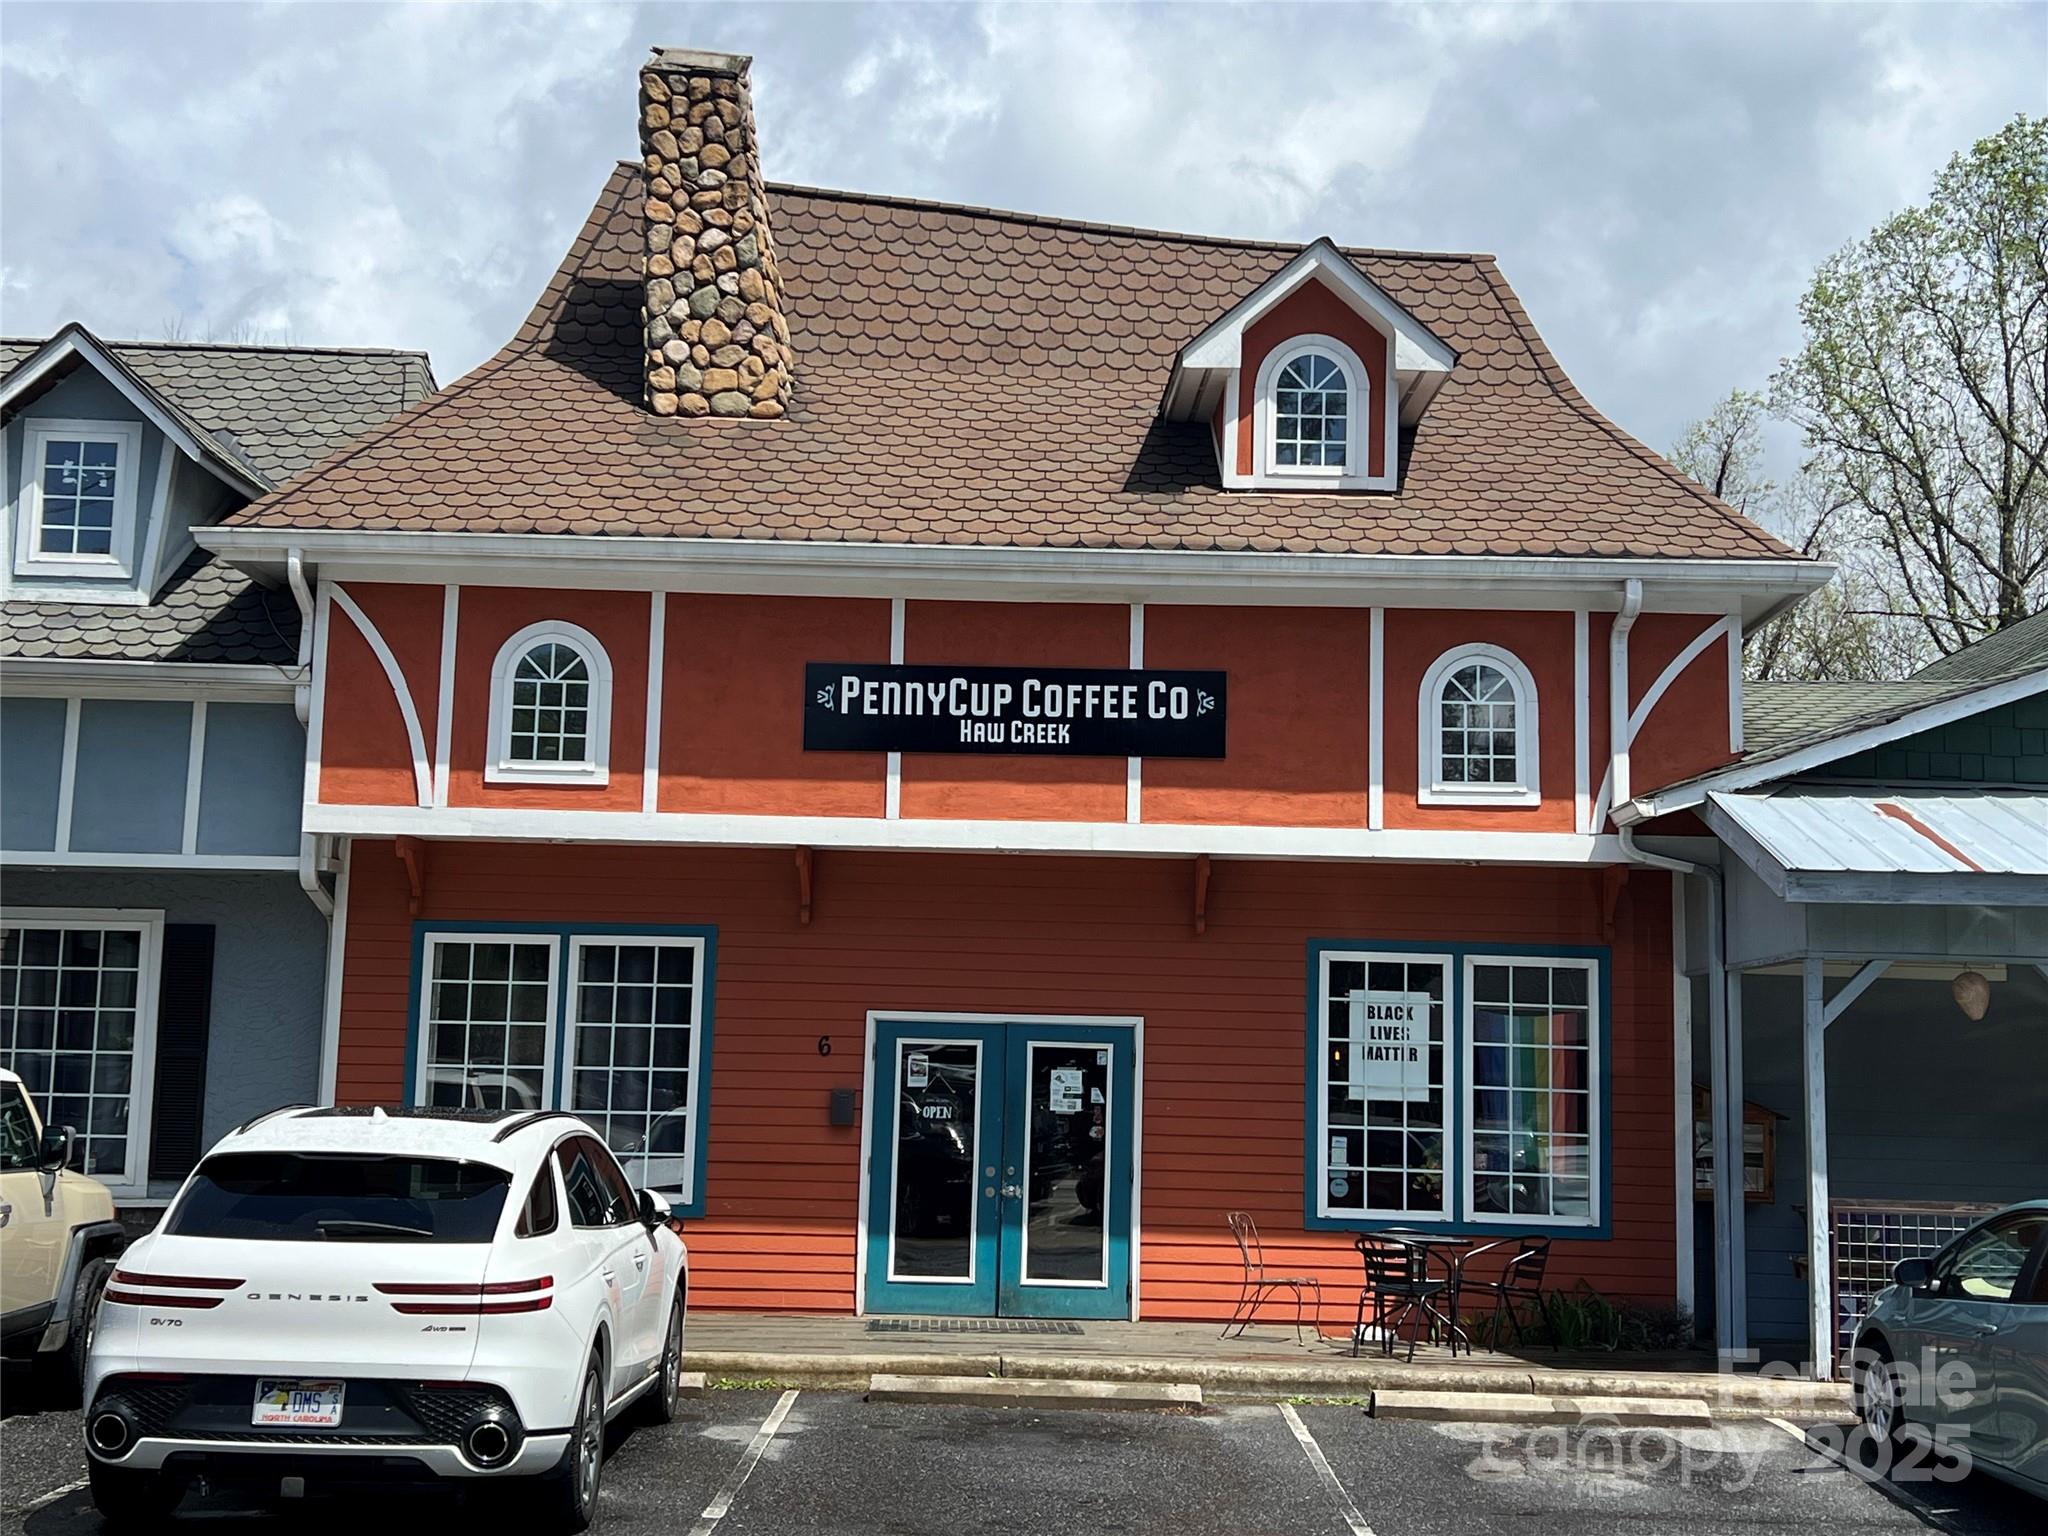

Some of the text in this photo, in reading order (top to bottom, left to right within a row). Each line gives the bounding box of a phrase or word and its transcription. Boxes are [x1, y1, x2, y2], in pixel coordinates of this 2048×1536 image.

[1011, 720, 1070, 744] CREEK
[1367, 1005, 1414, 1021] BLACK
[1370, 1025, 1410, 1040] LIVES
[818, 1036, 832, 1056] 6
[922, 1105, 953, 1119] OPEN
[247, 1293, 369, 1302] GENESIS
[150, 1318, 183, 1327] GV70
[292, 1392, 322, 1413] DMS
[262, 1414, 333, 1424] NORTH CAROLINA
